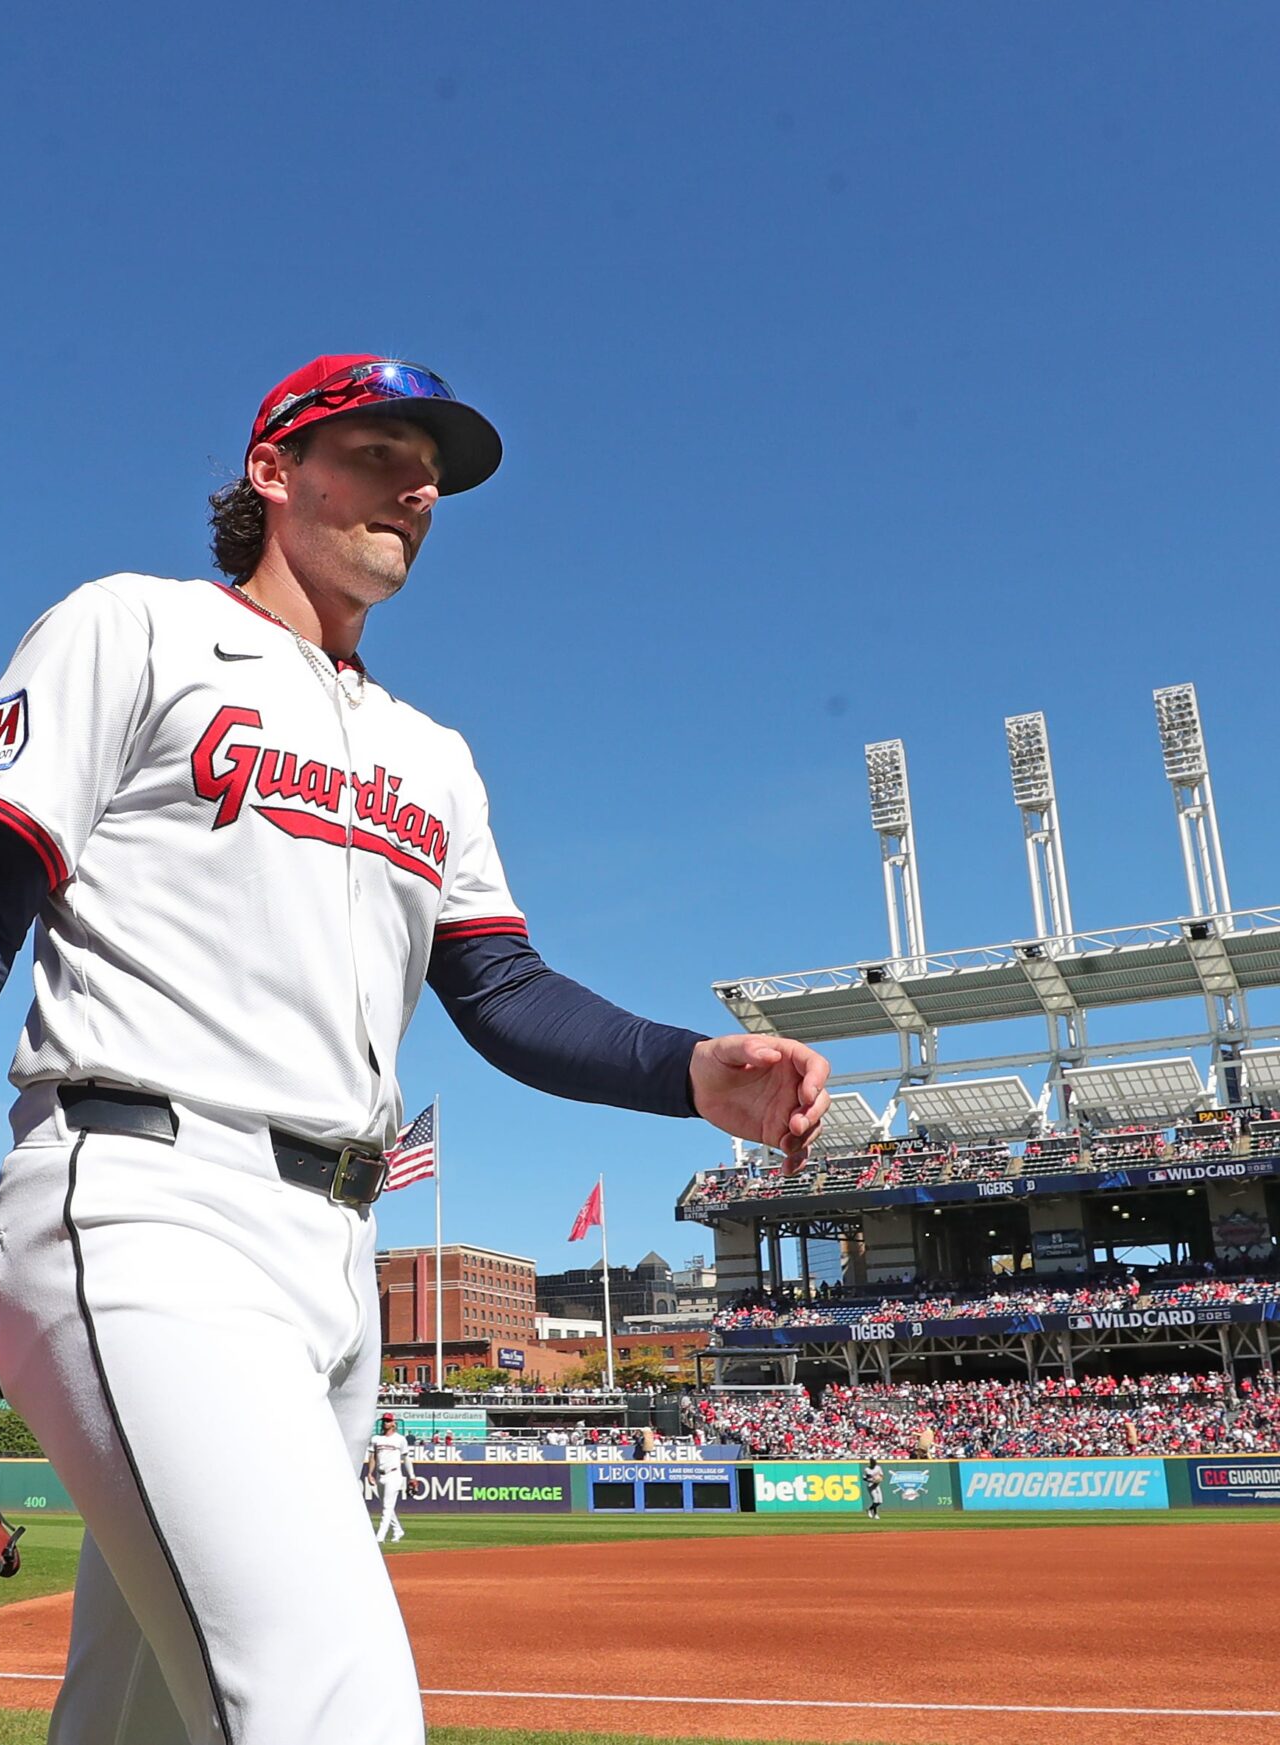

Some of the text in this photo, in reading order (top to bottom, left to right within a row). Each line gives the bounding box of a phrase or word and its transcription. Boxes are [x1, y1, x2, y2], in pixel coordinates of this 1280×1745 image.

[192, 706, 449, 864] Guardian
[1167, 1166, 1206, 1181] WILD
[1206, 1163, 1246, 1178] CARD
[977, 1181, 1014, 1196] TIGERS
[1092, 1309, 1231, 1329] WILD CARD 2025
[849, 1322, 895, 1342] TIGERS
[403, 1411, 441, 1419] Cleveland
[442, 1411, 482, 1419] Guardians
[473, 1487, 562, 1500] MORTGAGE
[755, 1474, 861, 1502] bet365
[967, 1471, 1151, 1498] PROGRESSIVE
[24, 1497, 46, 1508] 400
[937, 1497, 952, 1505] 375
